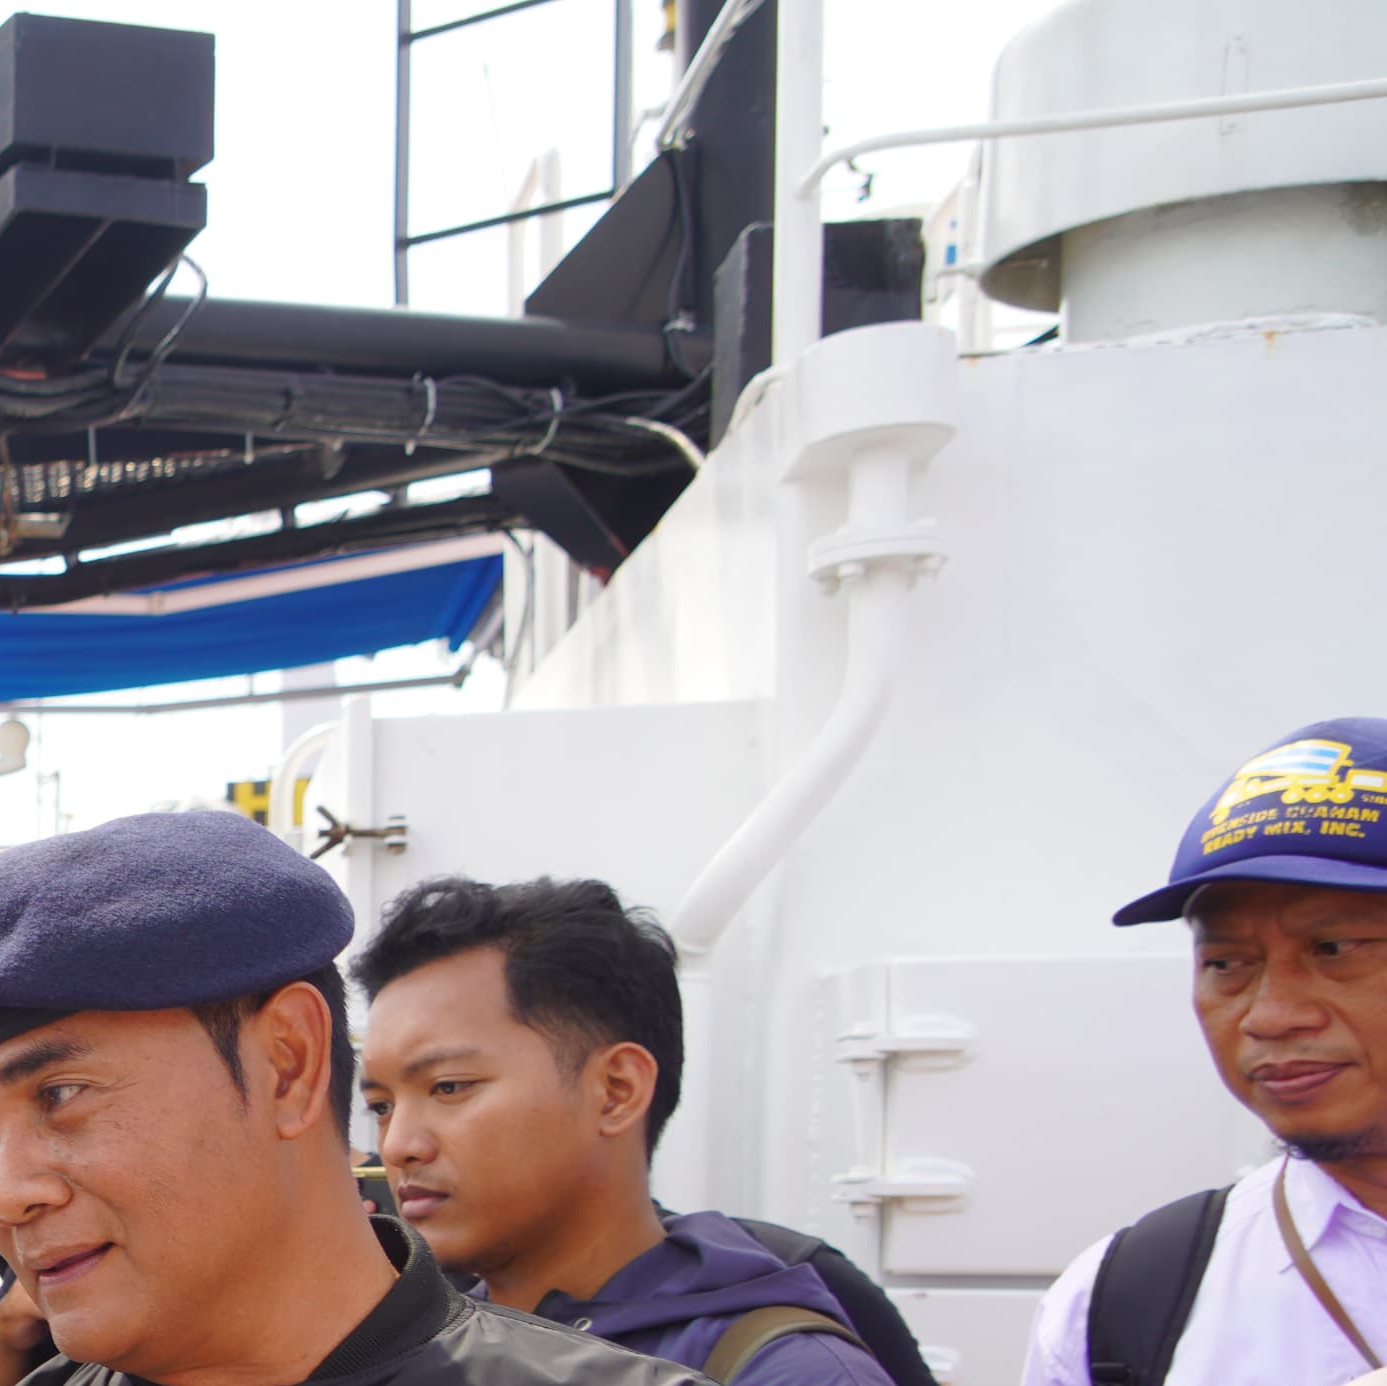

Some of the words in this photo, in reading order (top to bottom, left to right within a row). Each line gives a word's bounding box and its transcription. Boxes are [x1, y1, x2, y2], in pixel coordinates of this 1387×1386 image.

[1202, 825, 1258, 855] READY
[1263, 821, 1312, 836] MIX,
[1320, 821, 1366, 838] INC.
